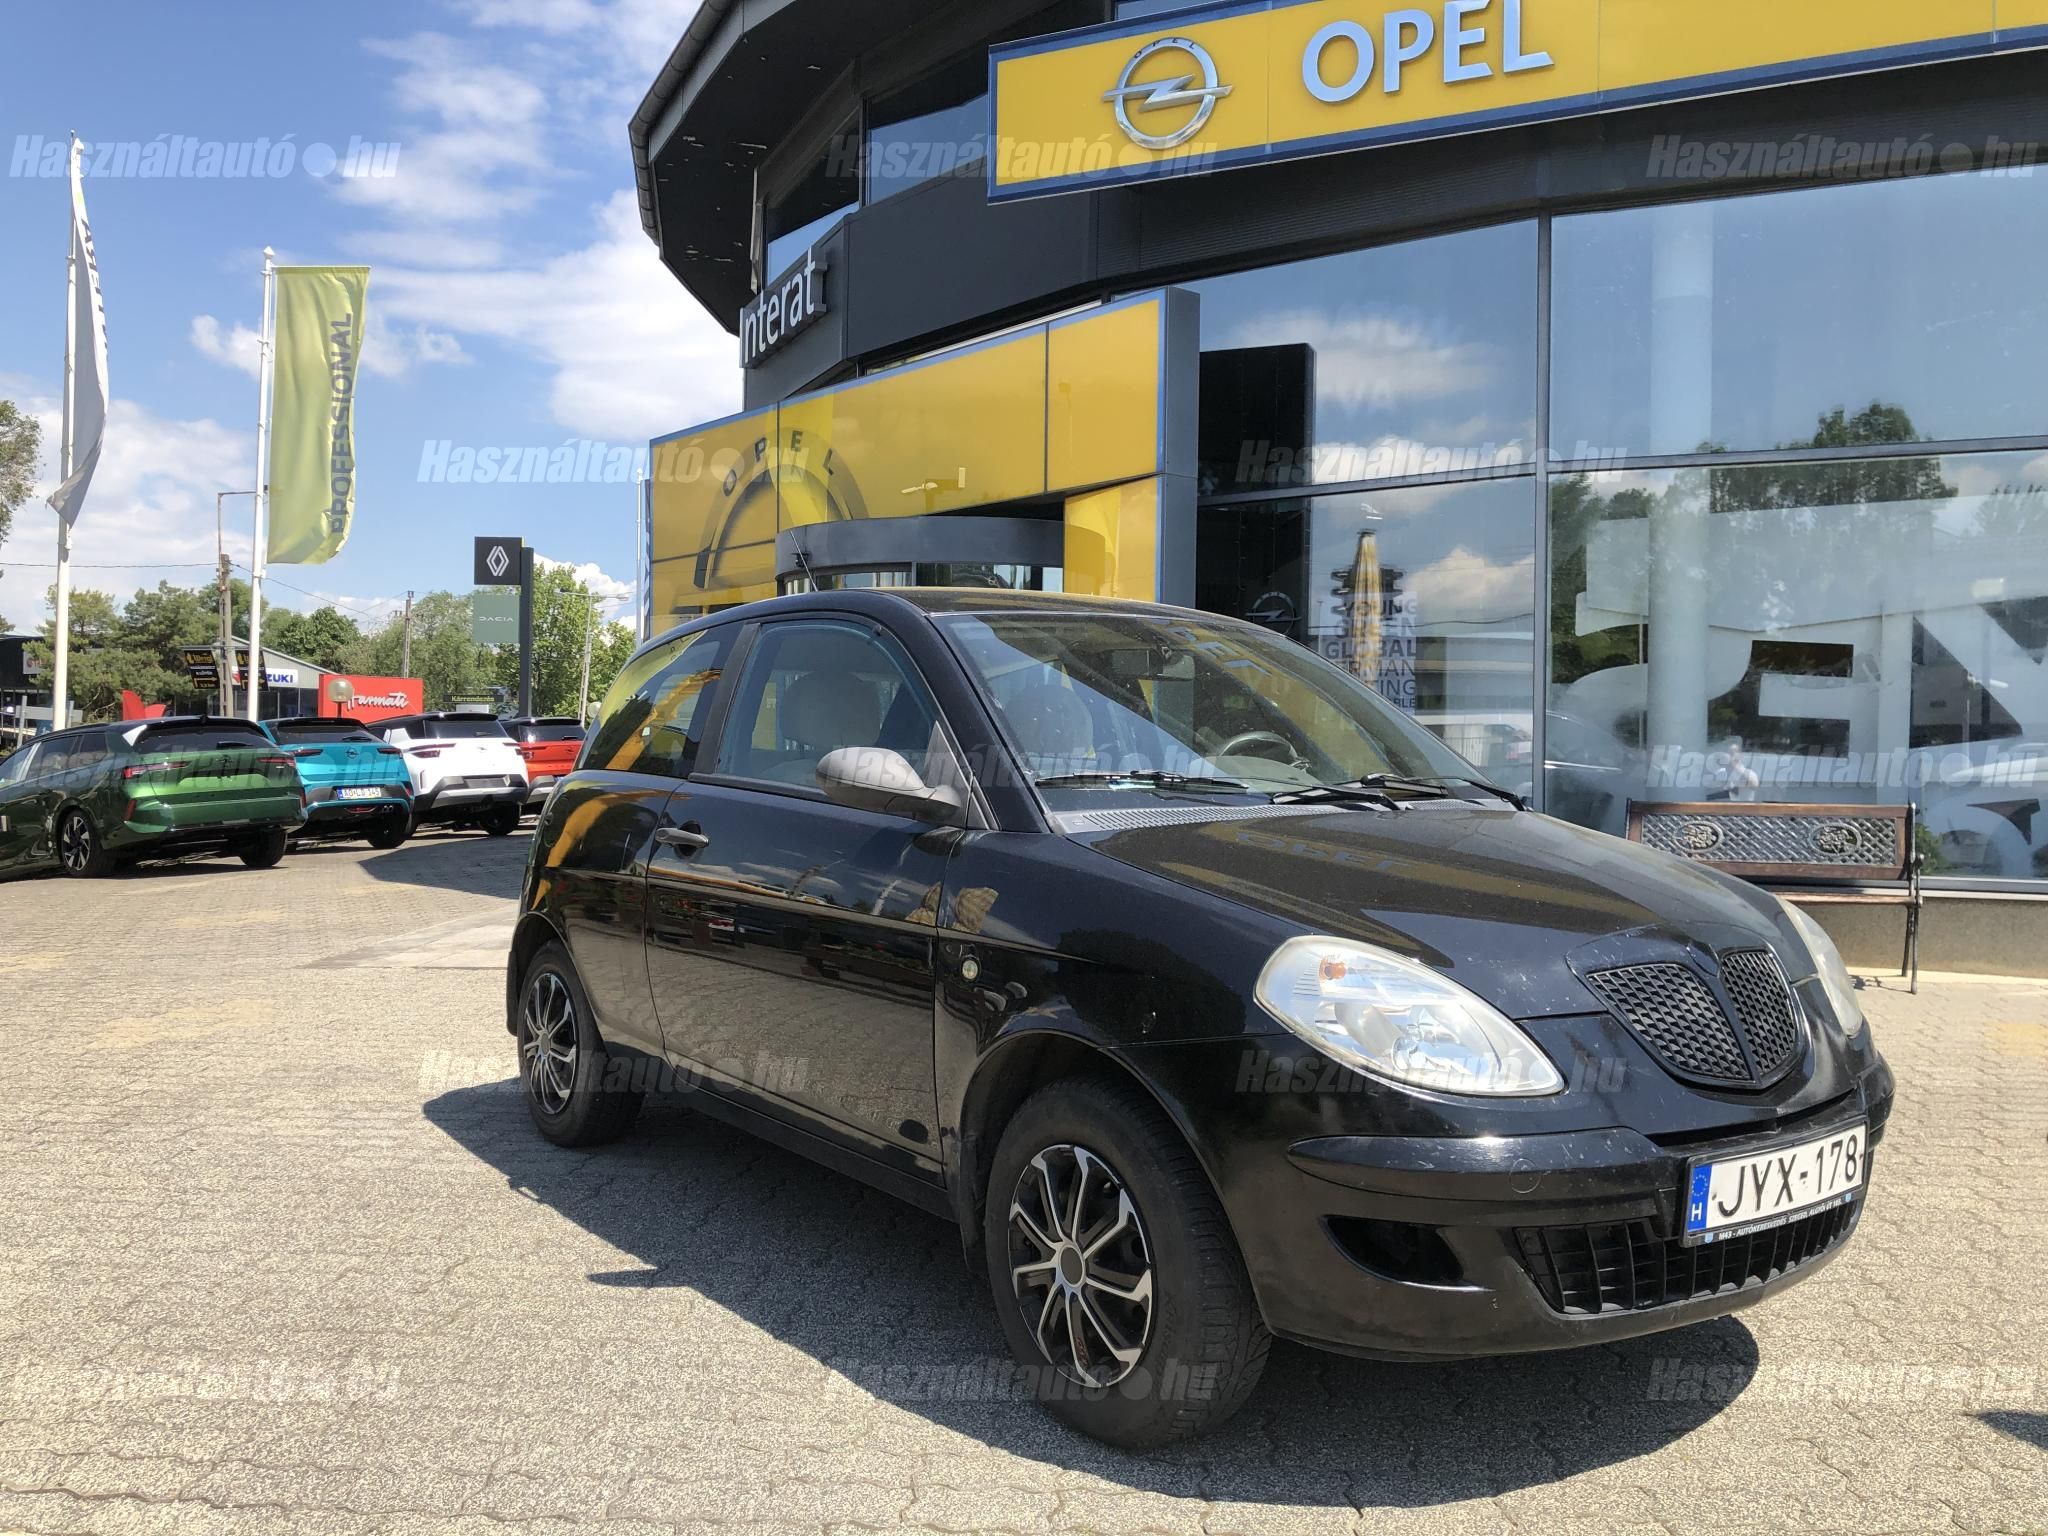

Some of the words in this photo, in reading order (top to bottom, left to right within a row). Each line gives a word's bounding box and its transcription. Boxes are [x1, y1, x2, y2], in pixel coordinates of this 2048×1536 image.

[1134, 37, 1196, 58] OPEL
[1302, 0, 1554, 102] OPEL
[739, 246, 816, 368] Interat
[330, 312, 353, 534] PROFESSIONAL
[722, 430, 834, 497] OPEL
[266, 673, 294, 683] ZUKI
[1690, 1202, 1702, 1222] H
[1718, 1133, 1858, 1218] JYX-178
